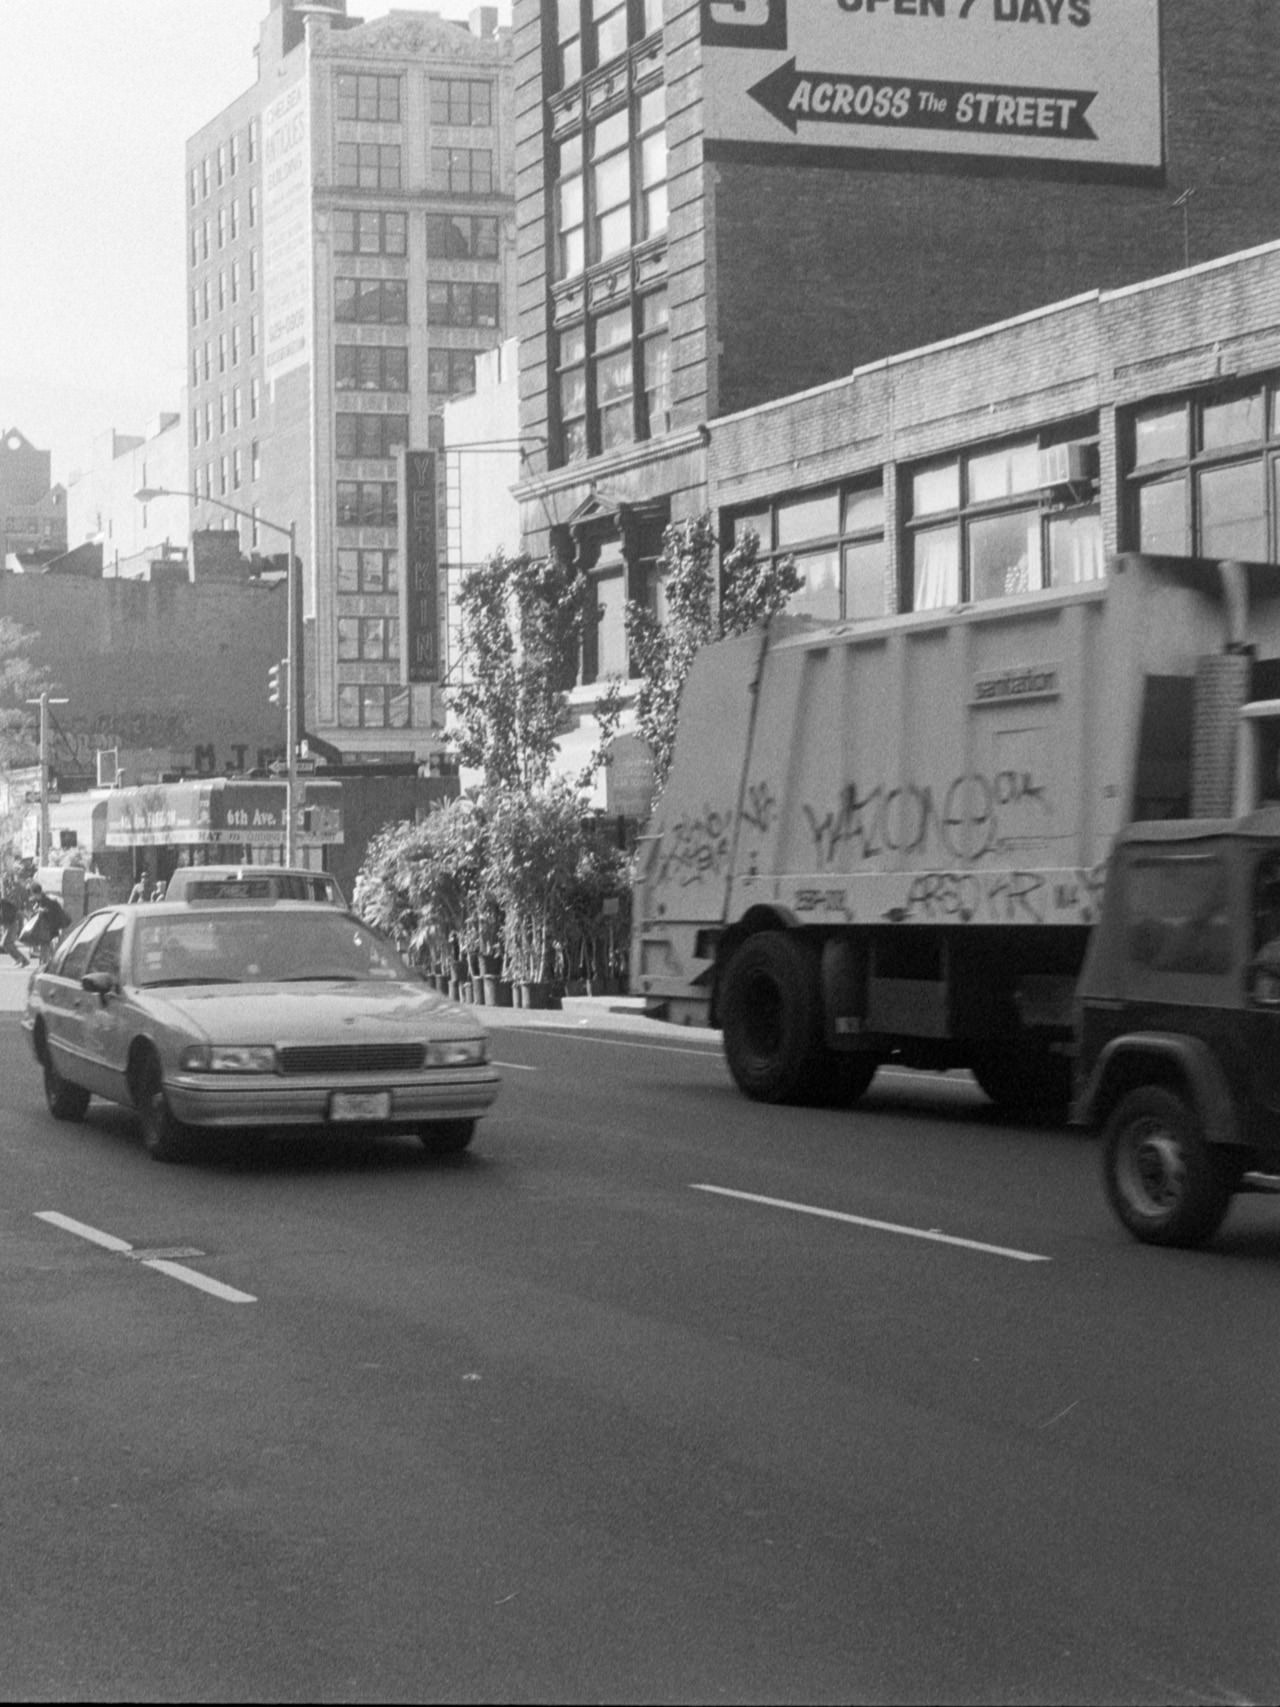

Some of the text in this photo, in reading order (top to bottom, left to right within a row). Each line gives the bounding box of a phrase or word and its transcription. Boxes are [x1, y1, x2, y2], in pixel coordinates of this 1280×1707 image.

[994, 0, 1091, 28] DAYS
[788, 80, 1077, 130] ACROSS The STREET
[227, 809, 248, 826] 6th
[253, 808, 276, 826] Ave.
